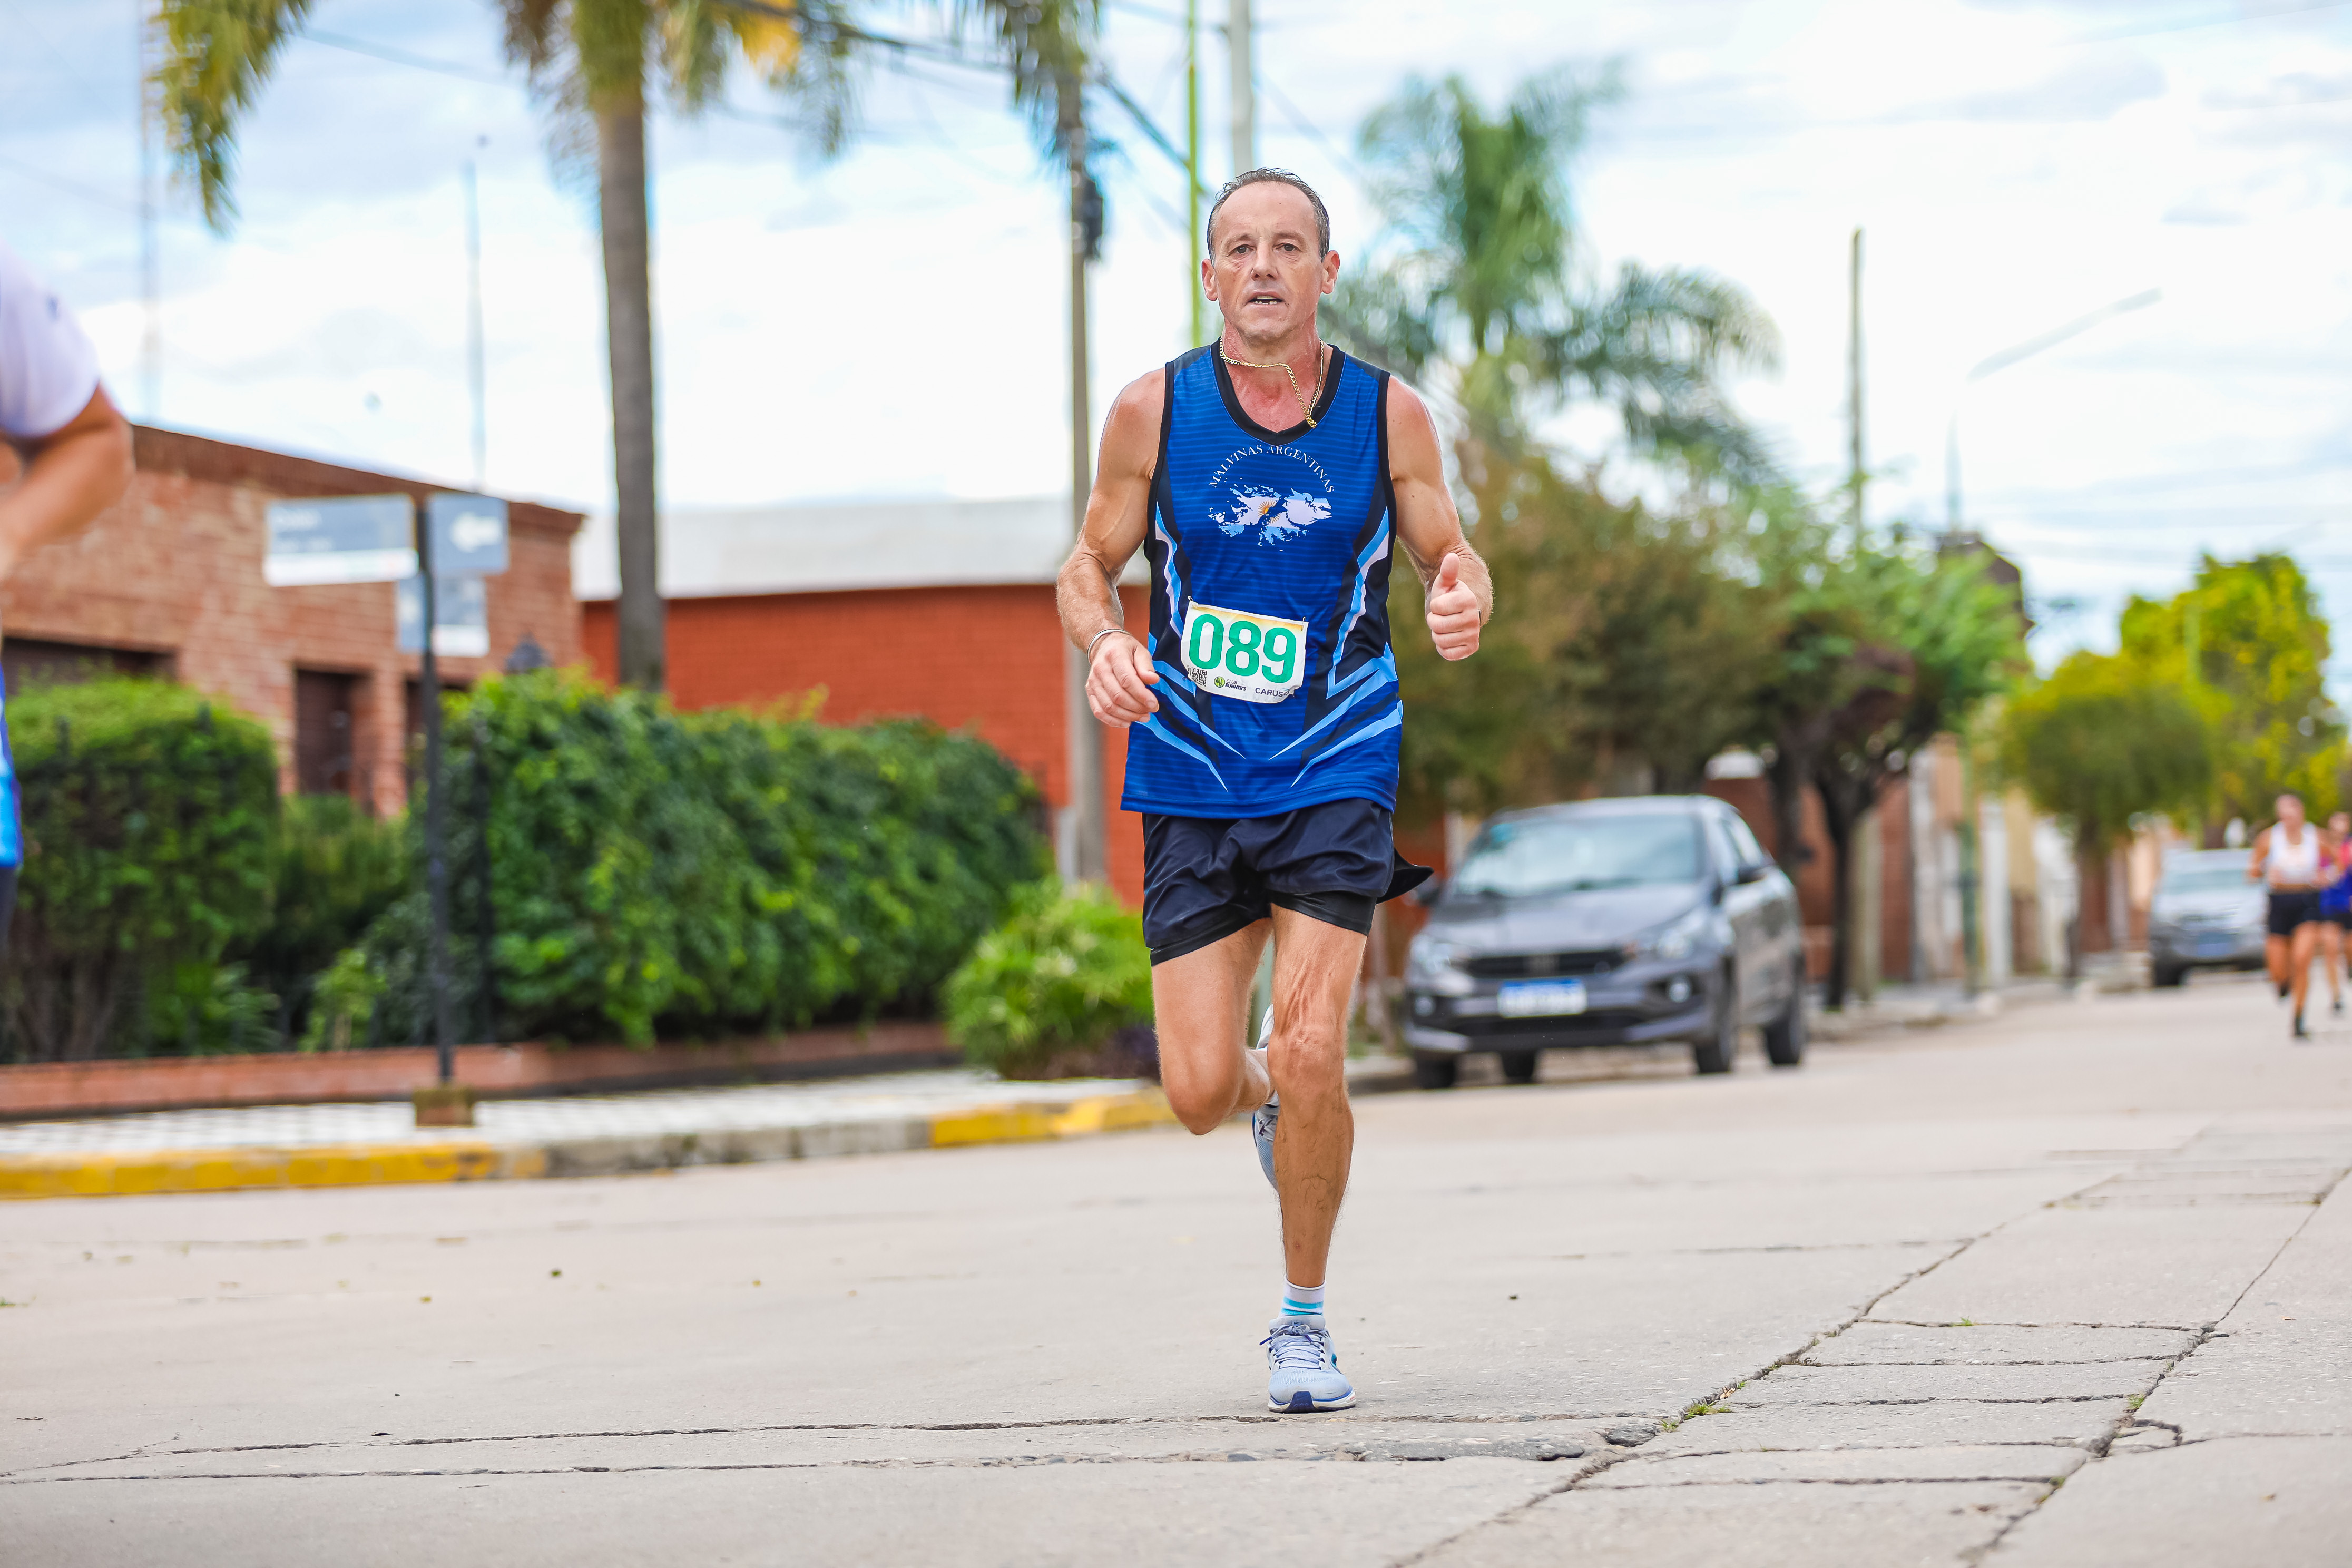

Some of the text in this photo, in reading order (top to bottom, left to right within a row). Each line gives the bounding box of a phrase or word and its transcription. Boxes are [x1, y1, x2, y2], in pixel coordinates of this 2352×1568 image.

[1209, 444, 1335, 494] MALVINAS ARGENTINAS
[1189, 614, 1297, 683] 089
